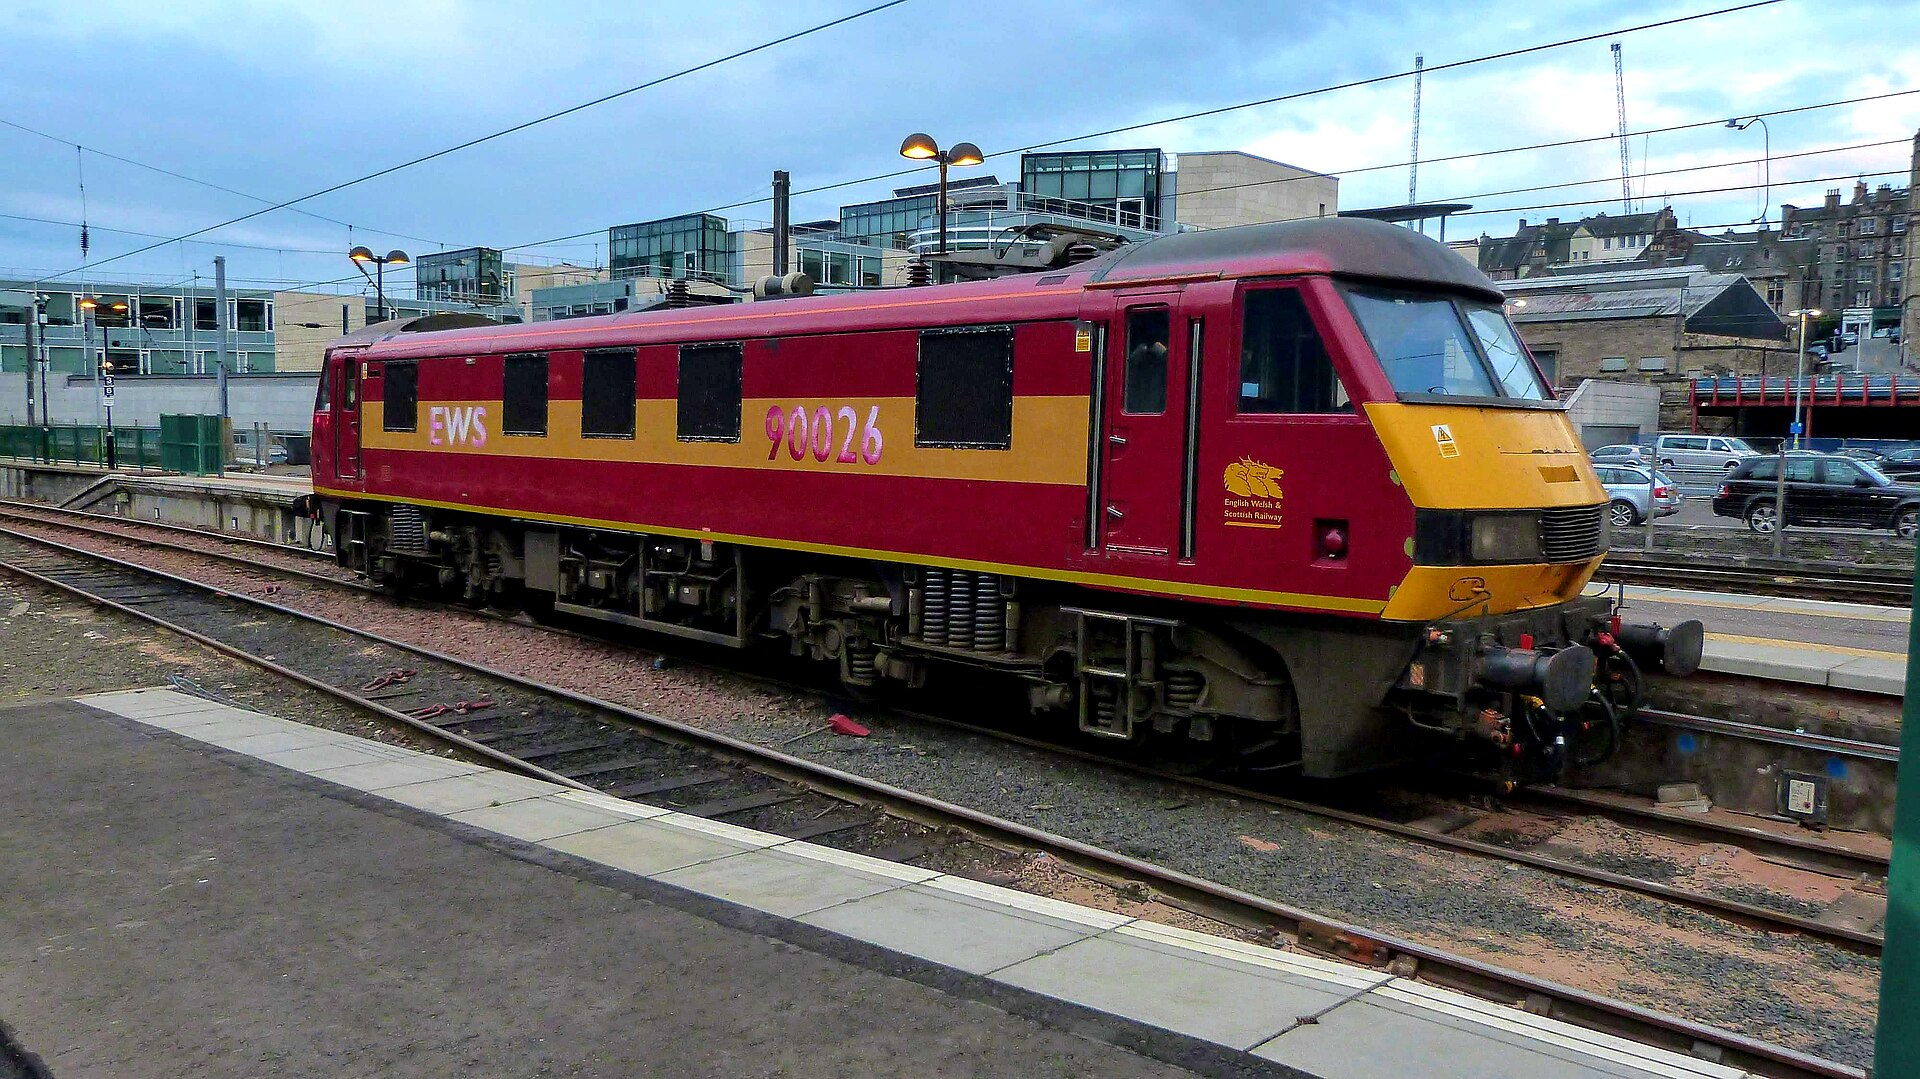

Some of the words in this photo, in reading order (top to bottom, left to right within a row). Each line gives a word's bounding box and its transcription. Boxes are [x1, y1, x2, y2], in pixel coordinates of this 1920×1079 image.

[430, 406, 487, 448] EWS
[765, 405, 883, 465] 90026
[1224, 498, 1249, 508] English
[1251, 500, 1273, 509] Welsh
[1275, 501, 1281, 509] &
[1224, 509, 1253, 519] Scottish
[1254, 511, 1282, 522] Railway
